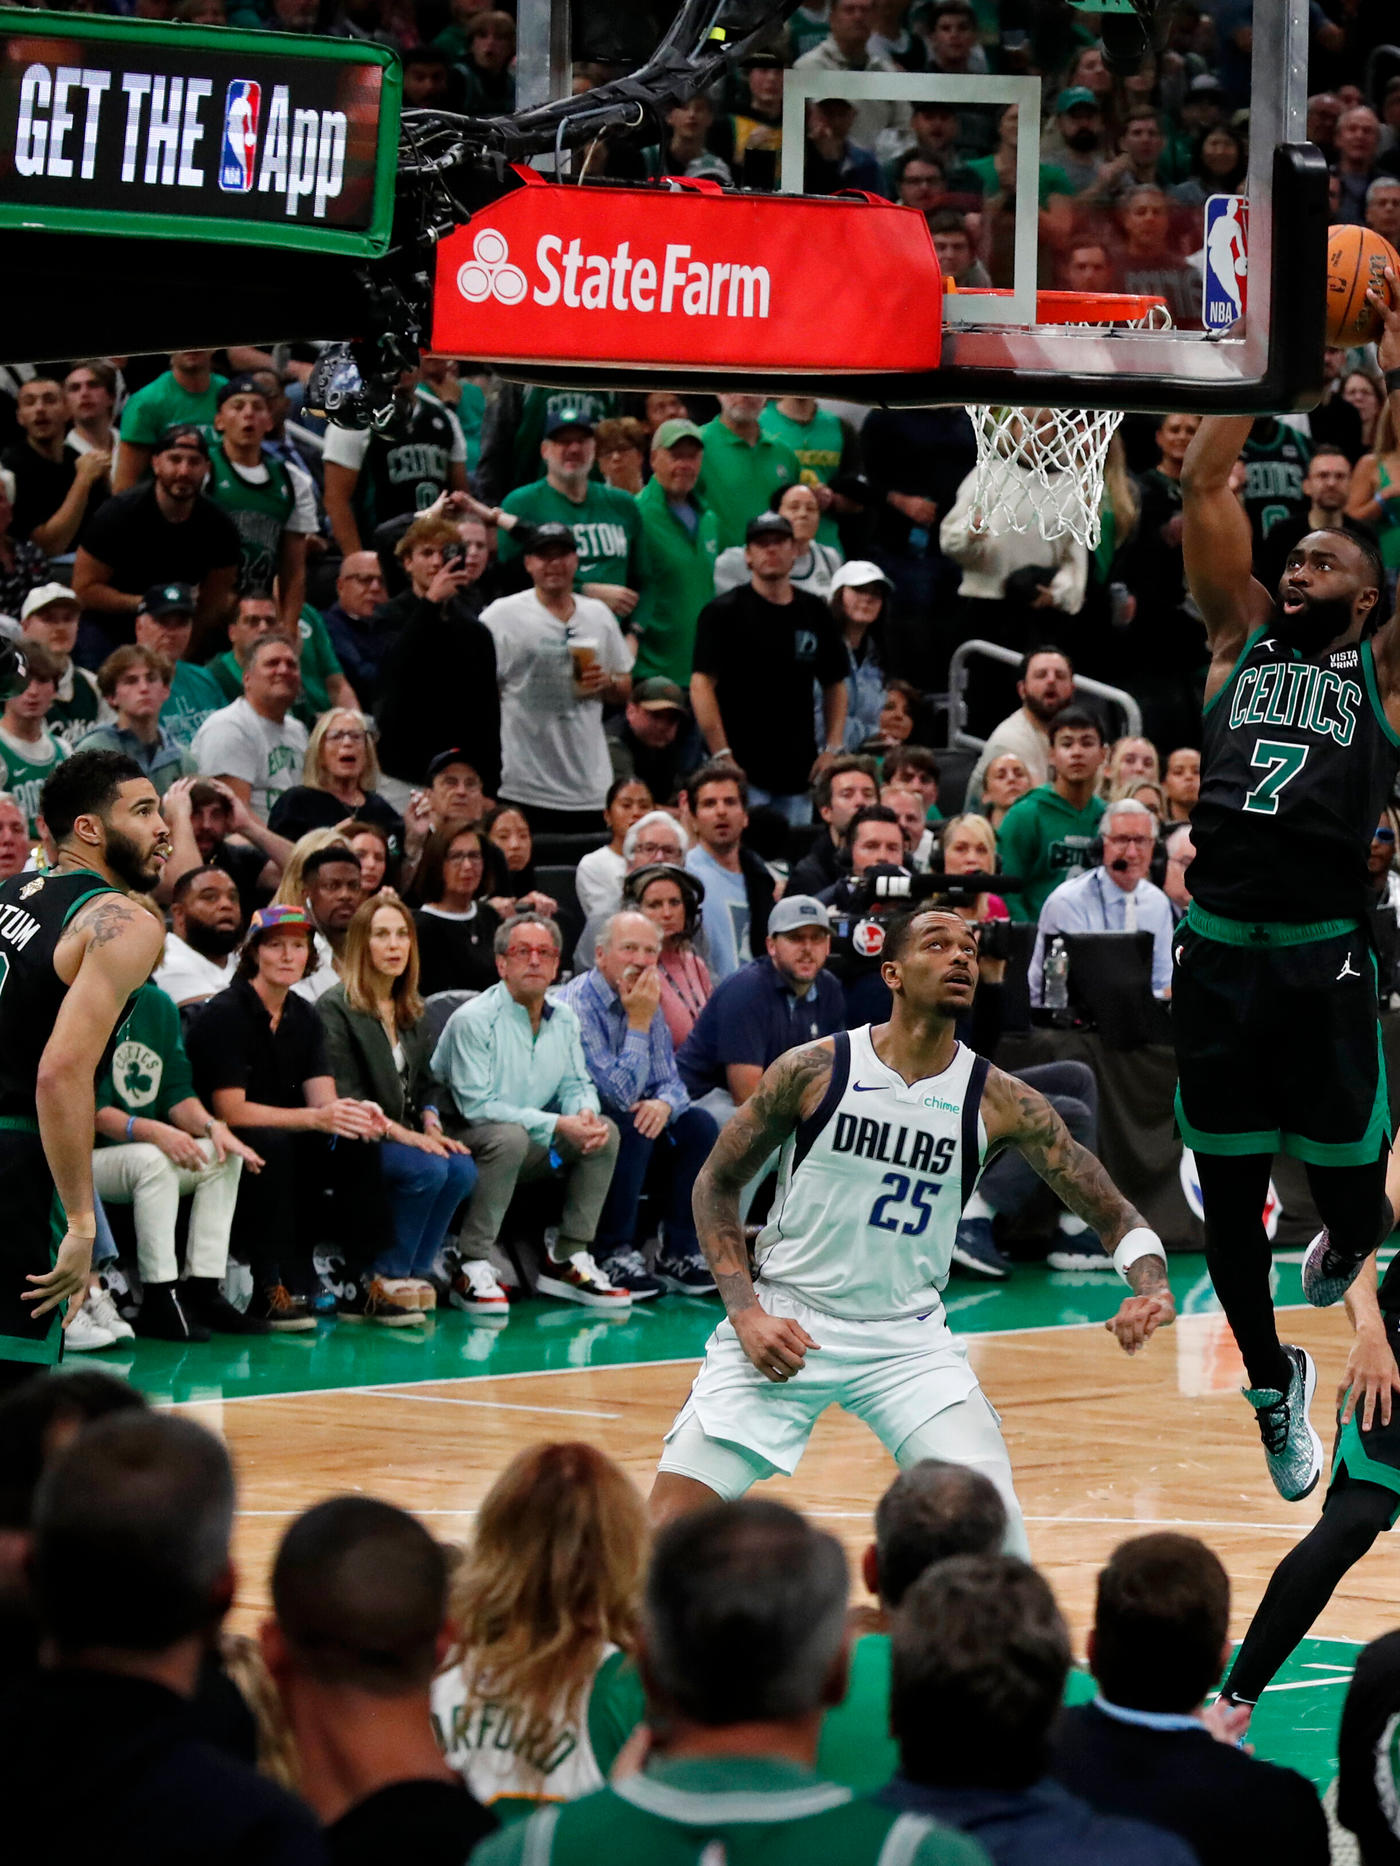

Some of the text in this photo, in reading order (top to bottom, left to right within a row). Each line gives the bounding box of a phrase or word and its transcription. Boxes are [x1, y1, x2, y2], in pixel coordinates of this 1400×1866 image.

[15, 63, 347, 218] GET THE App
[1210, 301, 1232, 324] NBA
[571, 522, 628, 558] STON
[1330, 650, 1359, 664] VISTA
[1330, 659, 1359, 670] PRINT
[1229, 662, 1362, 748] CELTICS
[1242, 738, 1310, 816] 7
[115, 1043, 160, 1071] CELTICS
[923, 1094, 961, 1114] chime
[832, 1112, 957, 1176] DALLAS
[868, 1172, 942, 1236] 25
